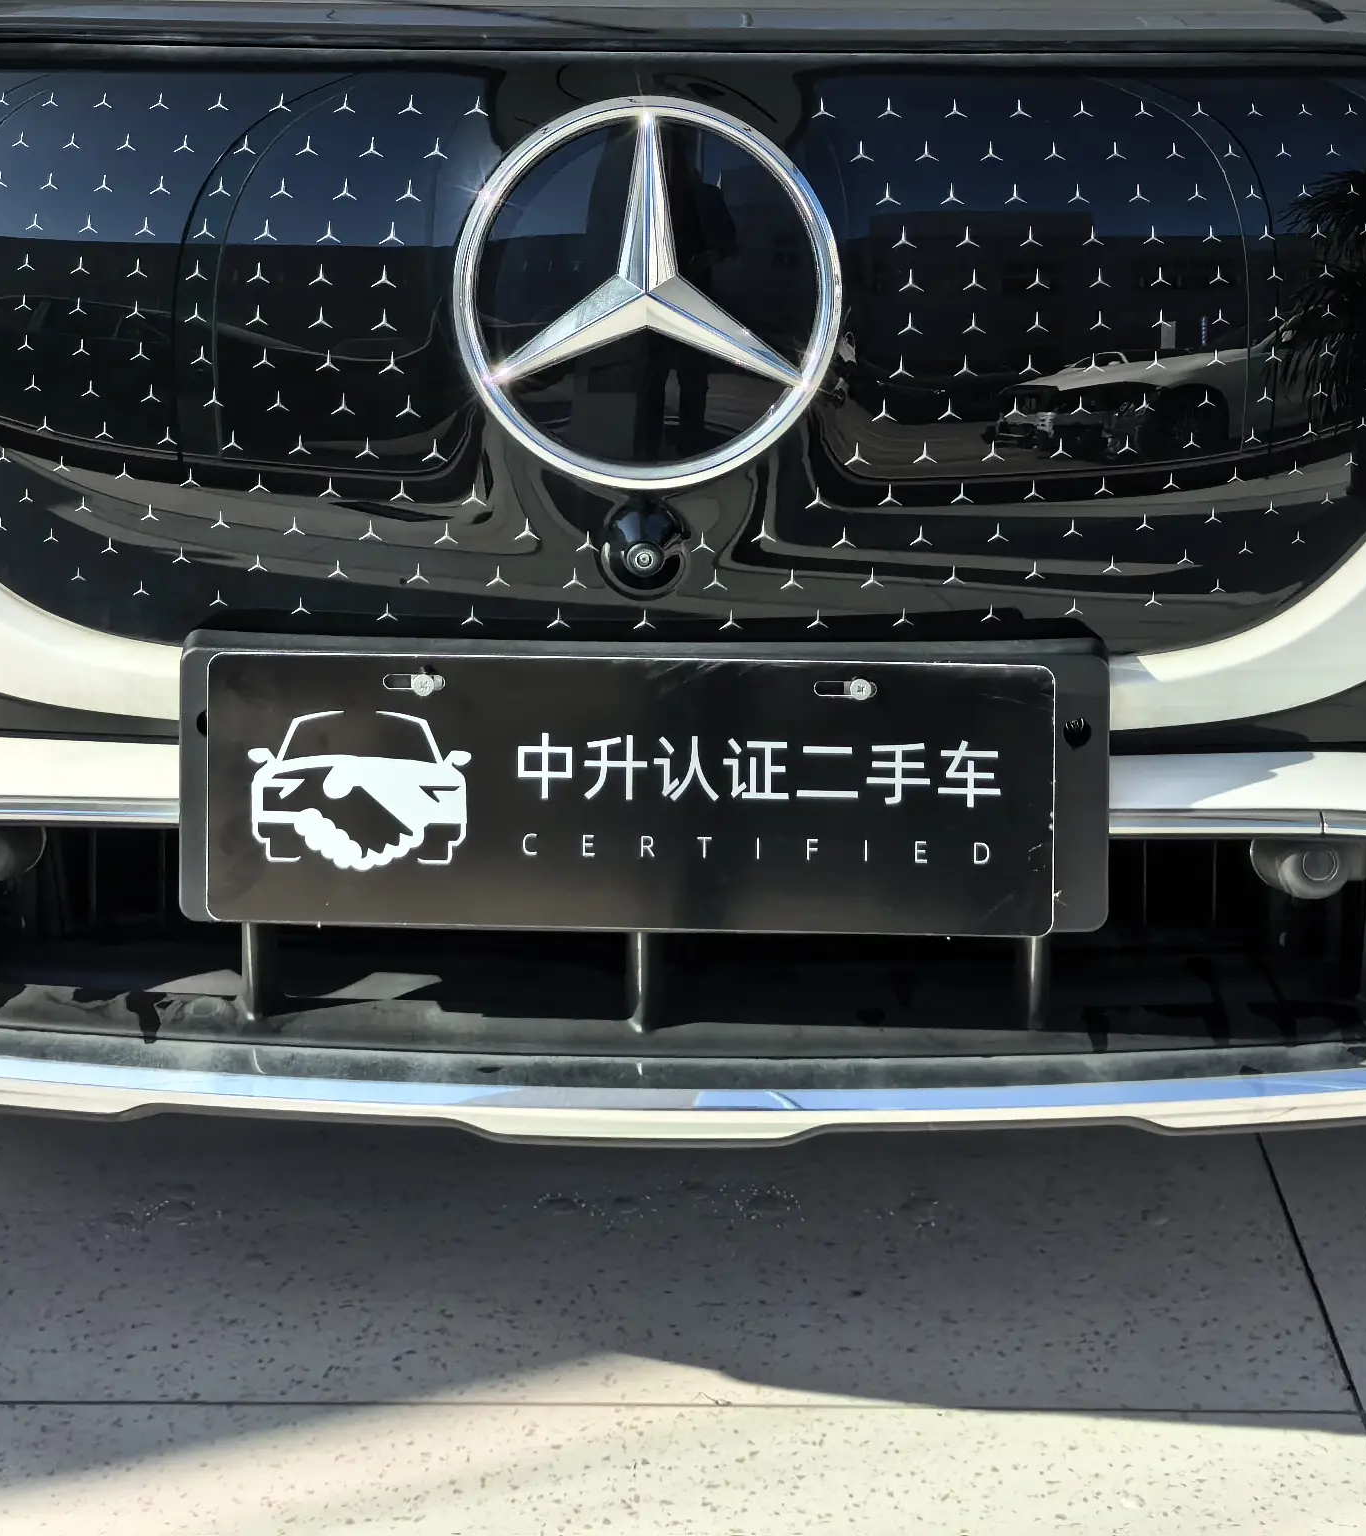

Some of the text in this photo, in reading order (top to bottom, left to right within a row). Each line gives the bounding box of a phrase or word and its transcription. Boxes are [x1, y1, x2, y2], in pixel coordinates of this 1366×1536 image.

[516, 732, 1002, 808] 中升认证二手车
[522, 832, 990, 865] CERTIFIED
